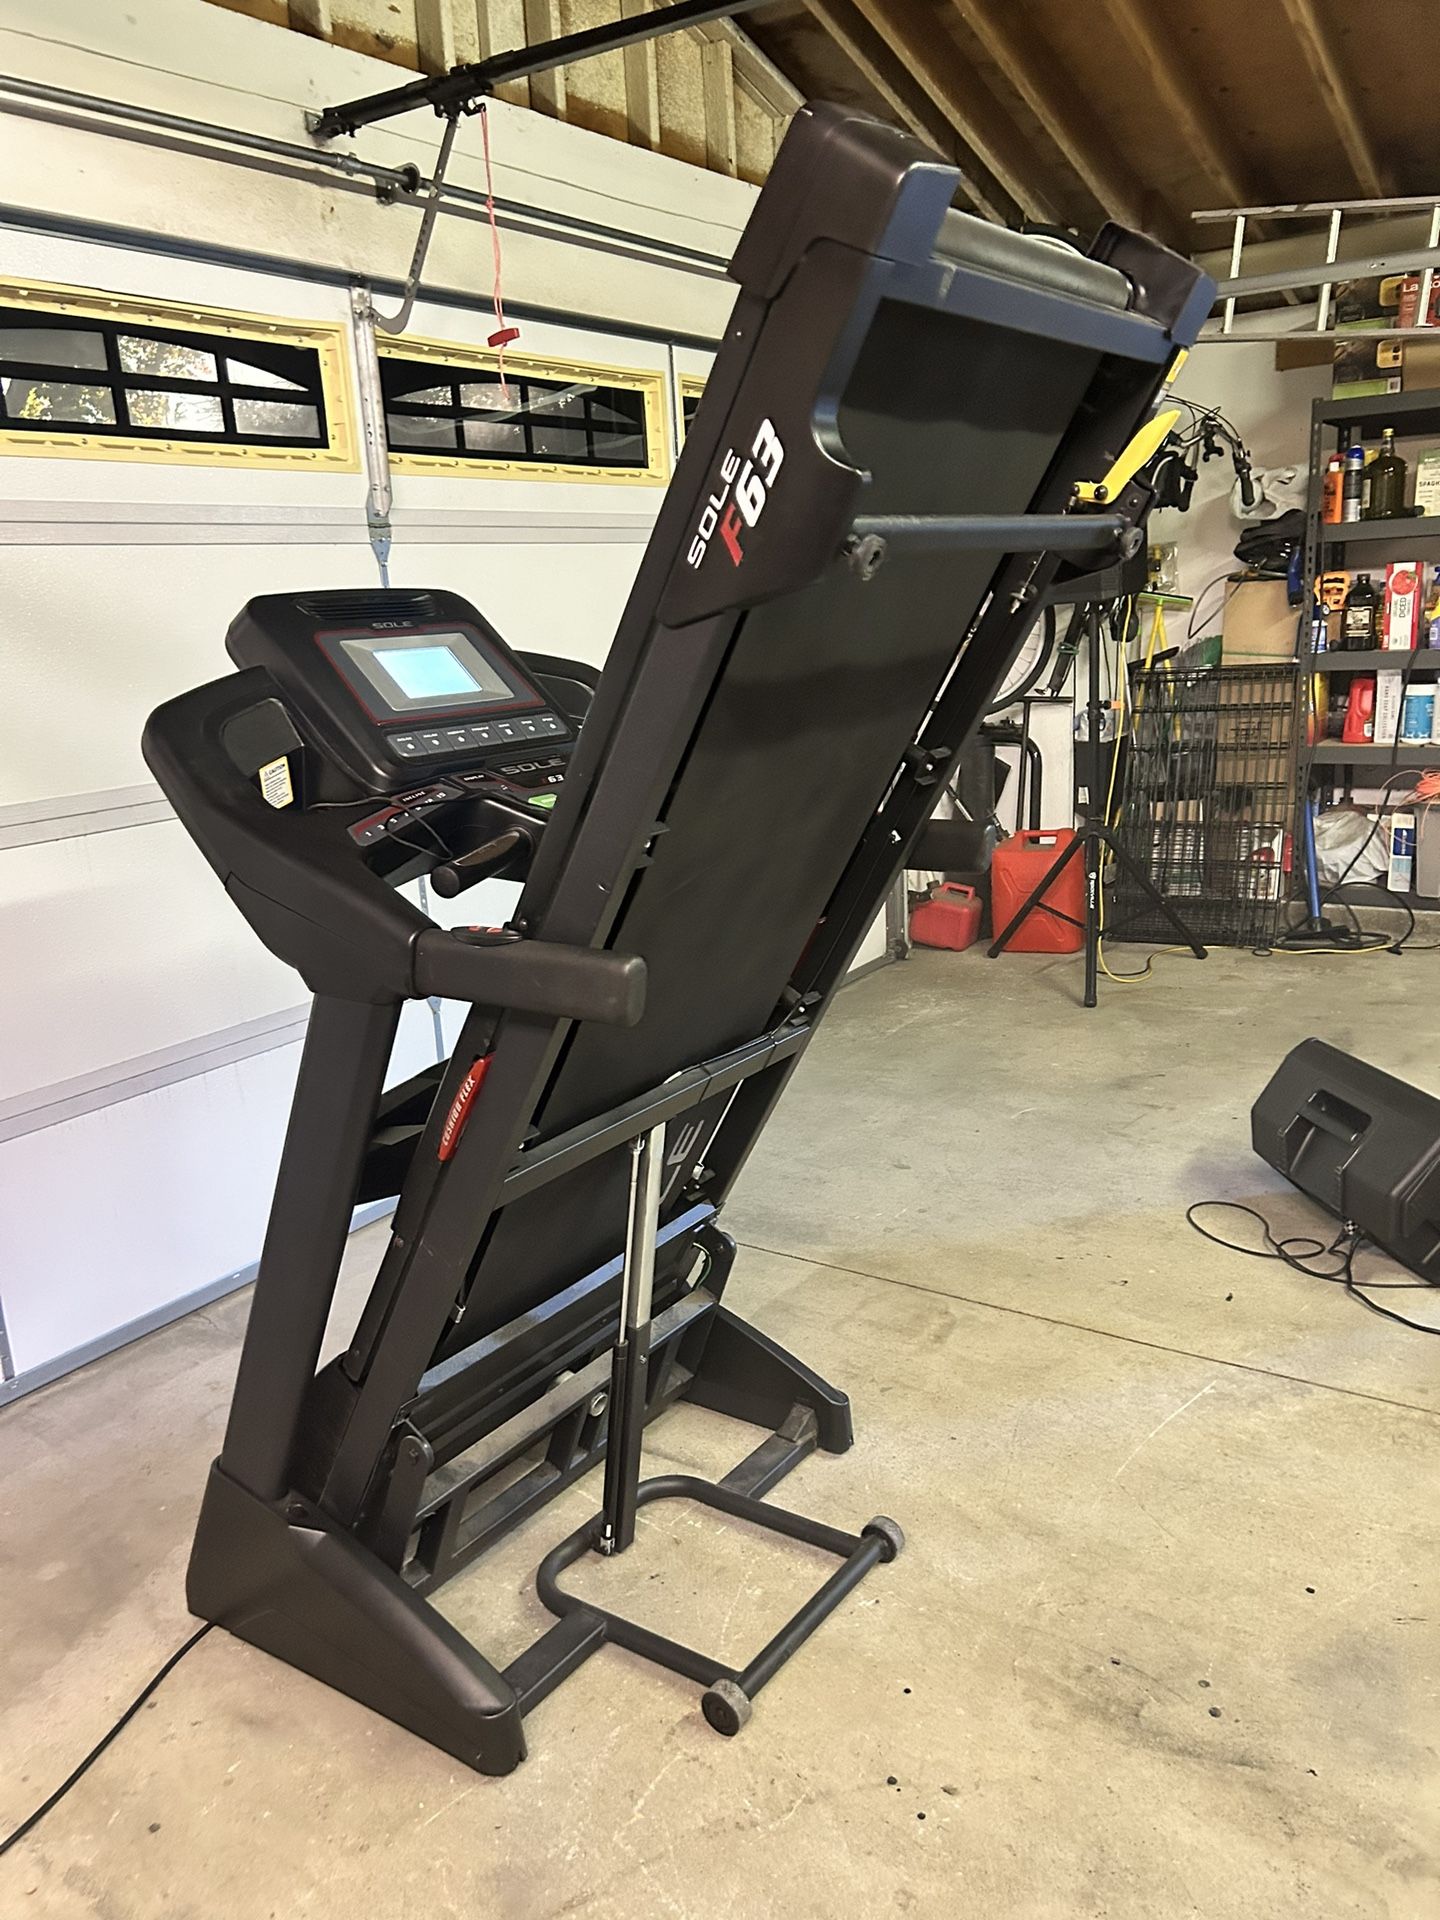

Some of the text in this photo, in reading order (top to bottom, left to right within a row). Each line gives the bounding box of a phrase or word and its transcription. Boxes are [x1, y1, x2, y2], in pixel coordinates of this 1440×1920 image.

[687, 447, 741, 569] SOLE
[720, 417, 784, 567] F63
[372, 620, 415, 629] SOLE
[1398, 597, 1407, 618] DICED
[500, 758, 567, 775] SOLE
[442, 1075, 476, 1146] CUSHION FLEX
